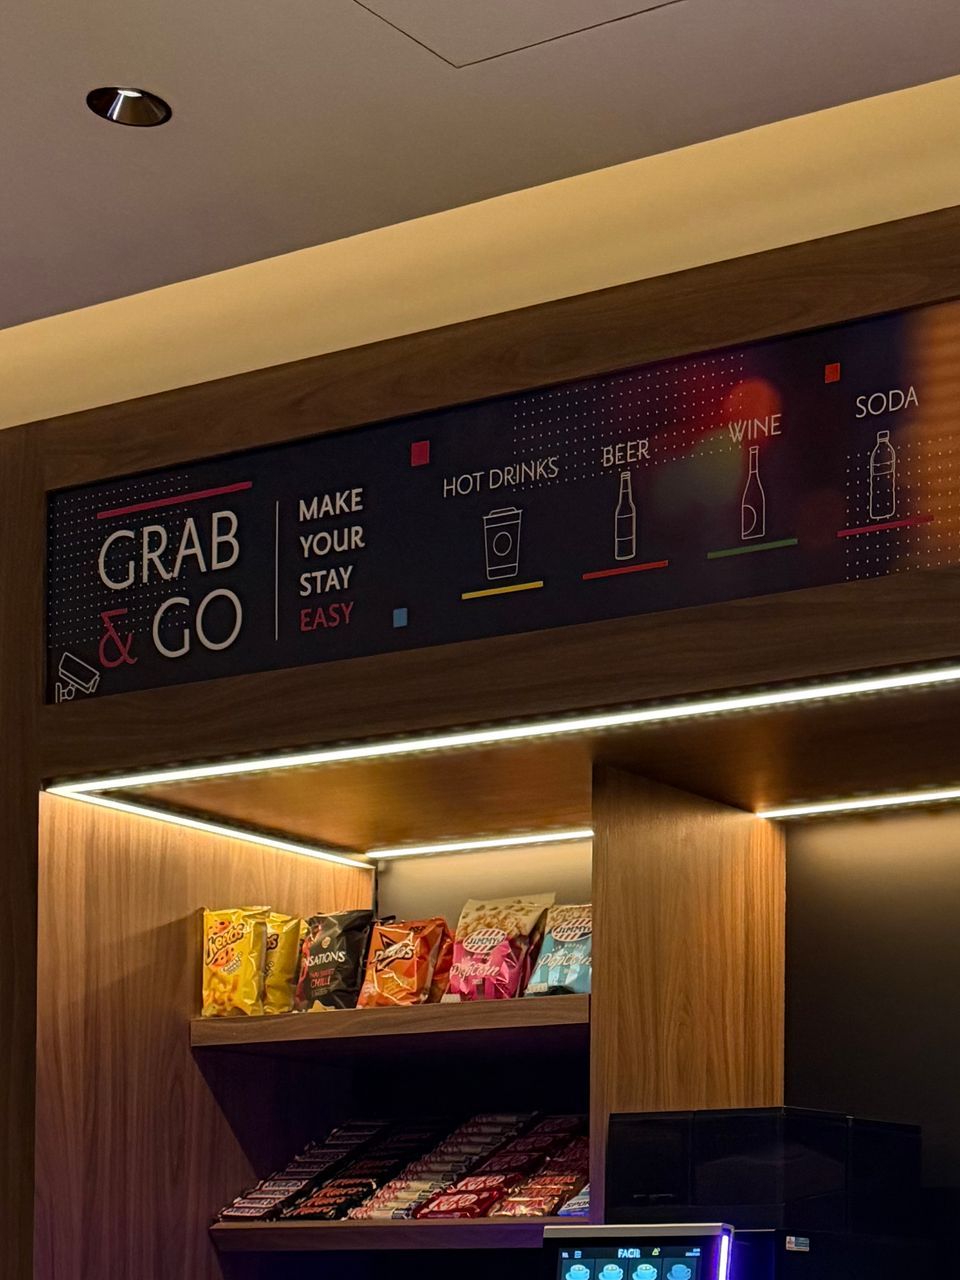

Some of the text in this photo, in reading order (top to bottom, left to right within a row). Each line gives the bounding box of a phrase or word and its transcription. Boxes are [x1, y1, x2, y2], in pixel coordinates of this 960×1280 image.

[855, 386, 919, 419] SODA
[728, 414, 782, 444] WINE
[602, 440, 650, 467] BEER
[443, 456, 560, 498] HOT DRINKS
[299, 488, 363, 522] MAKE
[98, 510, 241, 591] GRAB
[299, 526, 365, 558] YOUR
[299, 566, 353, 596] STAY
[98, 588, 243, 669] & GO
[299, 601, 354, 632] EASY
[303, 950, 346, 967] NSATIONS
[618, 1249, 640, 1258] FACIL
